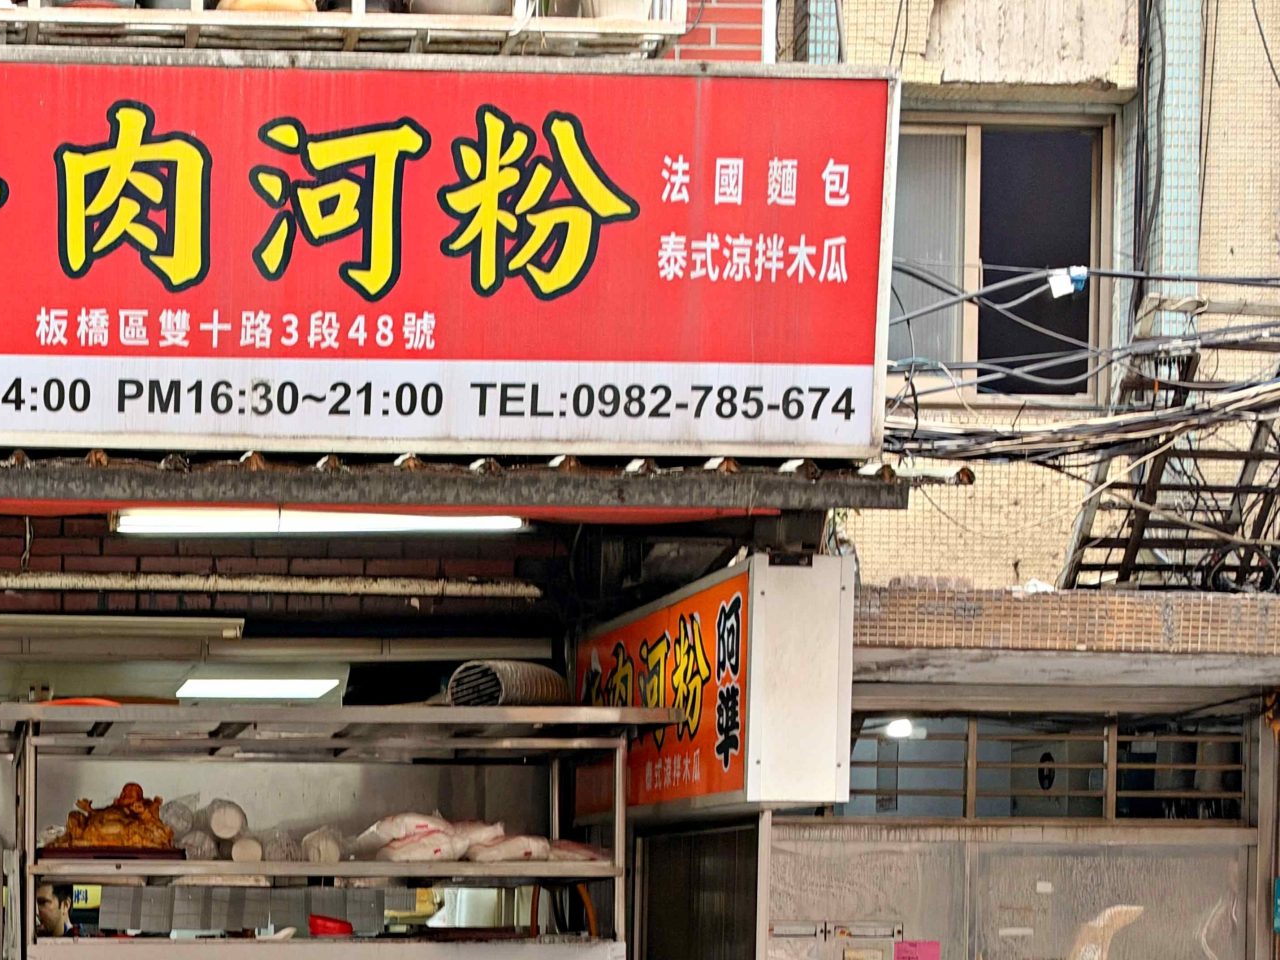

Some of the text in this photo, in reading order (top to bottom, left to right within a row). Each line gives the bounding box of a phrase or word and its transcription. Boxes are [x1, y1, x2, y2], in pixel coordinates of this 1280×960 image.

[661, 155, 850, 206] 法國麵包
[658, 232, 848, 284] 泰式涼拌木瓜
[36, 306, 435, 350] 板橋區雙十路3段48號
[117, 377, 443, 417] PM16:30~21:00
[470, 381, 855, 421] TEL:0982-785-674
